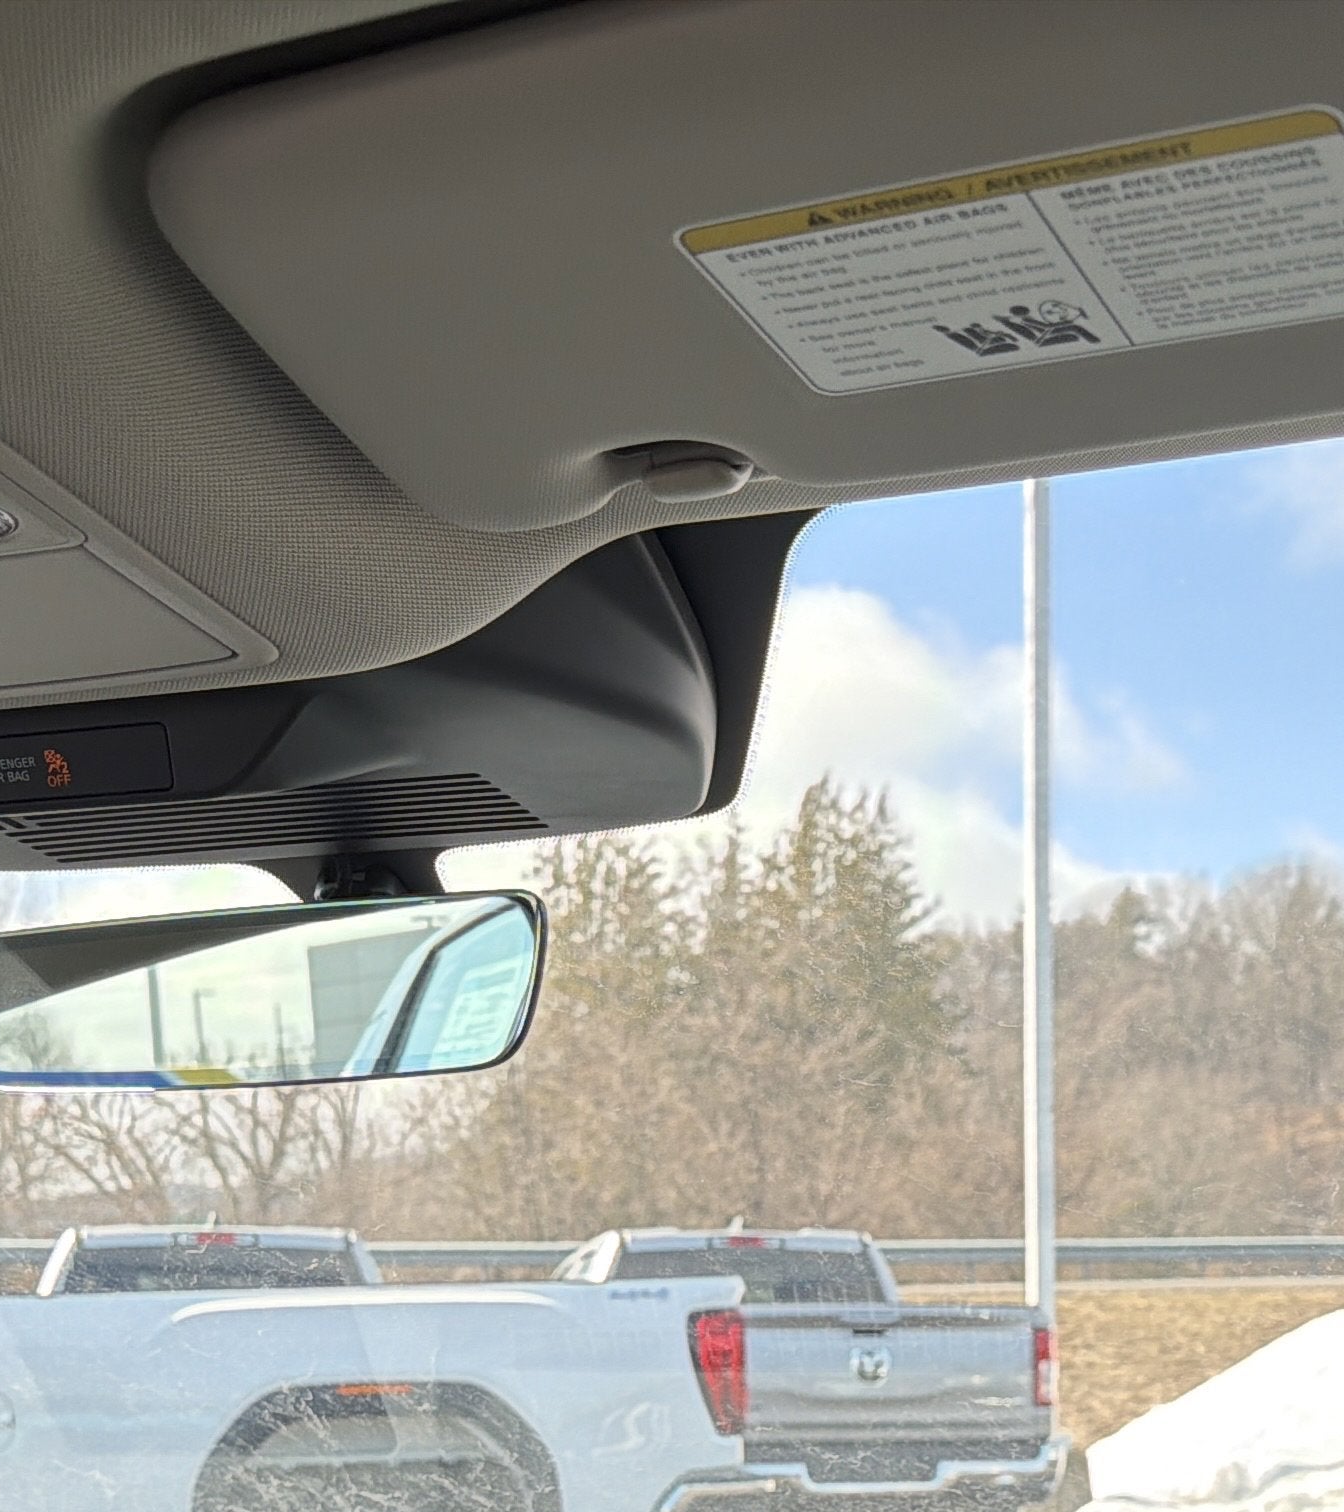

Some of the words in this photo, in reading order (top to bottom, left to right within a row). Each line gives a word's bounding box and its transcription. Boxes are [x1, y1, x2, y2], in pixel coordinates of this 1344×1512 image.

[776, 240, 818, 252] WITH
[824, 220, 916, 245] ADVANCED
[924, 213, 952, 225] AIR
[958, 204, 1007, 220] BAGS
[7, 771, 30, 782] BAG
[47, 774, 71, 787] OFF
